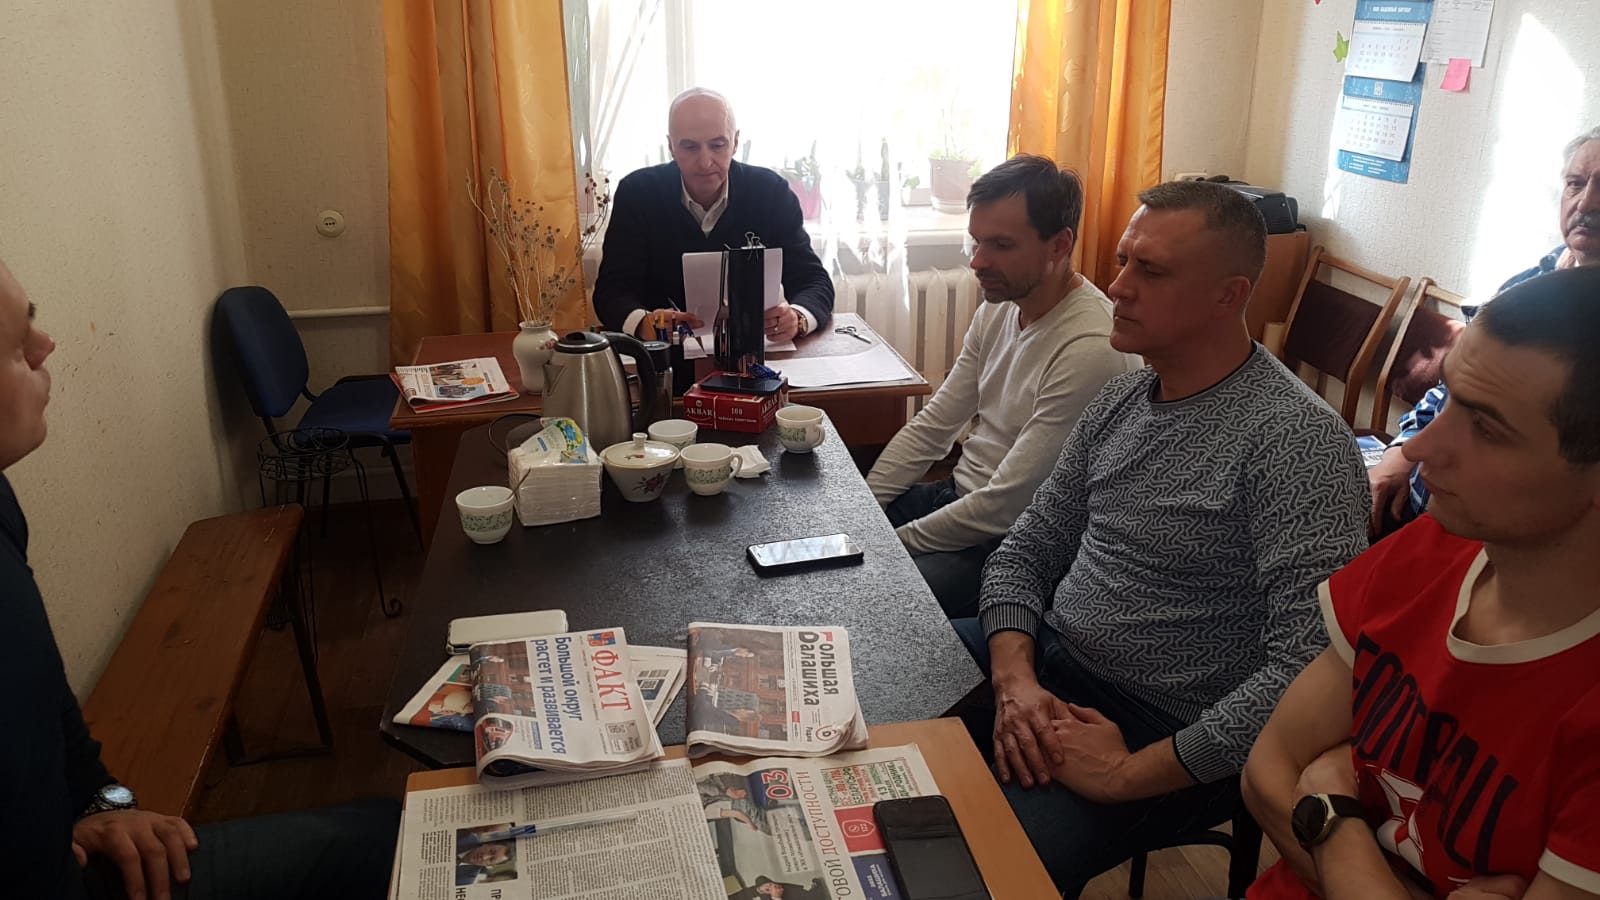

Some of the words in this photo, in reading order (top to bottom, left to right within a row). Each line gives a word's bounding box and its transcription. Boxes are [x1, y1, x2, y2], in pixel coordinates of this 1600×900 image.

[687, 408, 713, 416] AKBAR
[731, 408, 743, 416] 100
[530, 639, 552, 674] растет
[555, 636, 580, 688] Большой
[541, 676, 550, 684] и
[591, 650, 632, 711] ФАКТ
[537, 686, 566, 754] развивается
[561, 690, 583, 720] округ
[761, 769, 794, 800] 03
[796, 772, 839, 855] ДОСТУПНОСТИ
